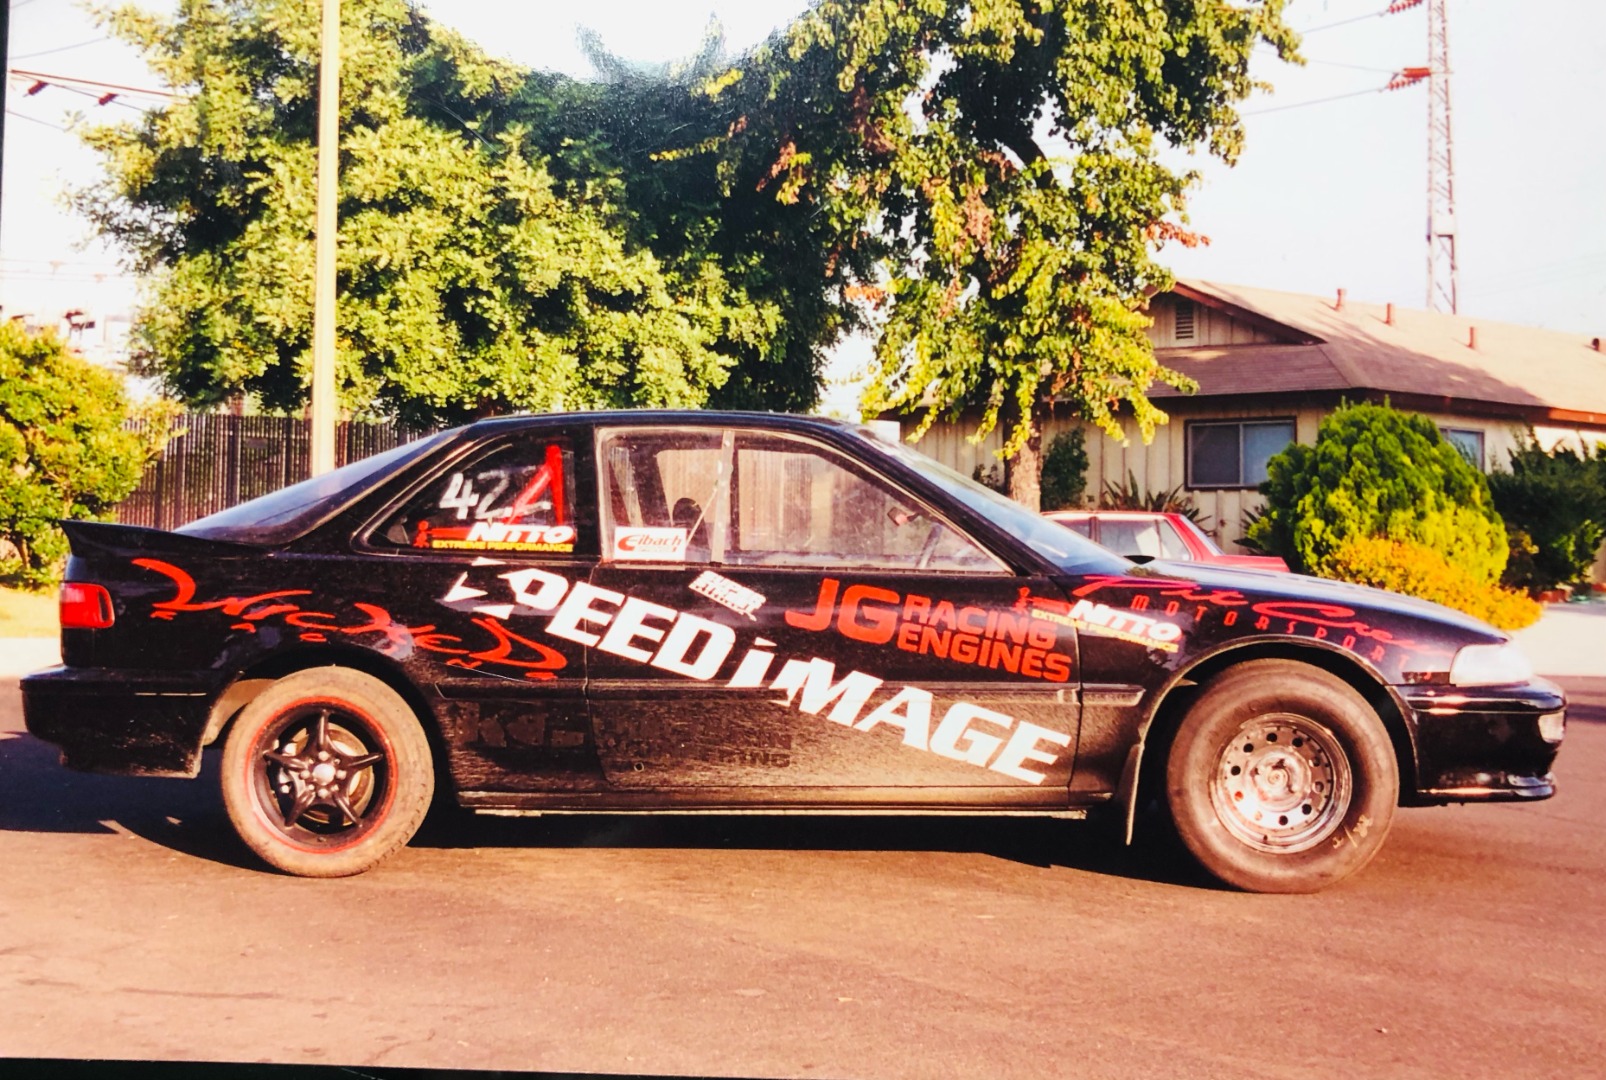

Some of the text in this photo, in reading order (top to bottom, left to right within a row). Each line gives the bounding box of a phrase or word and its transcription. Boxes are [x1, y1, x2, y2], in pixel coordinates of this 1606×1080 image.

[432, 540, 574, 552] EXTREME PERFORMANCE
[465, 521, 575, 544] NITTO
[617, 533, 682, 552] Eibach
[785, 577, 900, 645] JG
[902, 594, 1059, 650] RACING
[1031, 609, 1180, 653] EXTREME PERFORMANCE
[1067, 599, 1182, 642] NITTO
[897, 620, 1073, 683] ENGINES
